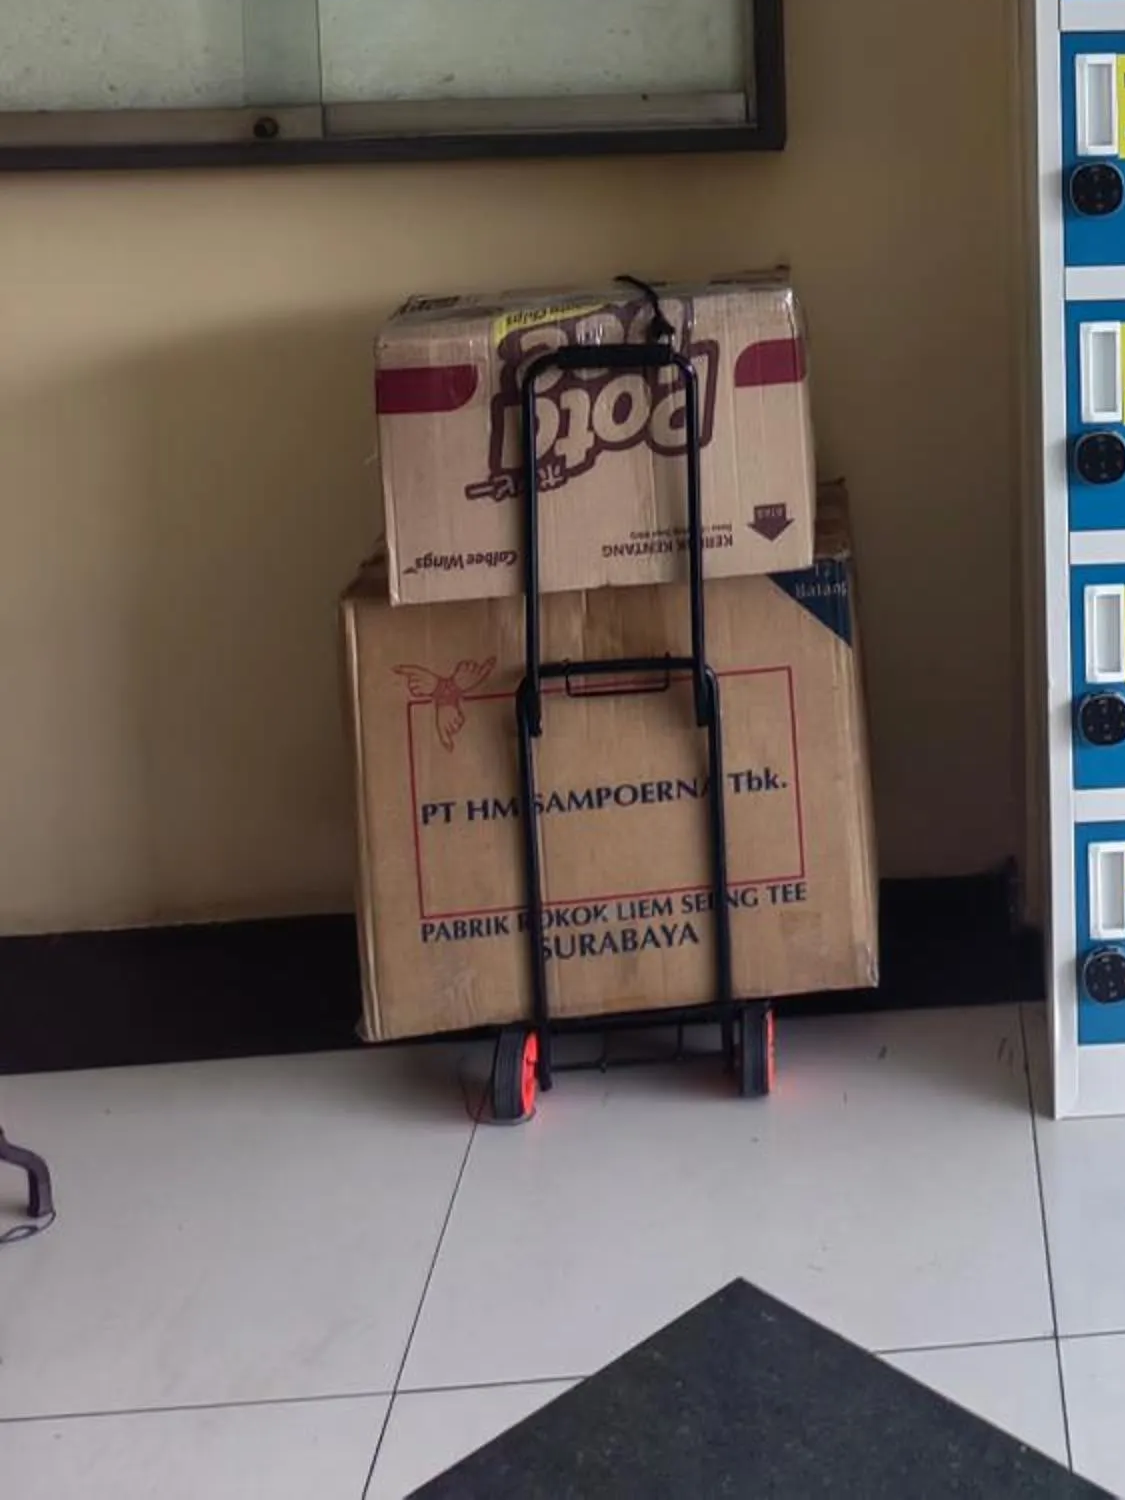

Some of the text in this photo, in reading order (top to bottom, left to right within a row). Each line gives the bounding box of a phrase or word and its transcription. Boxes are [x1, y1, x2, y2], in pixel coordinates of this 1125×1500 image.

[415, 550, 518, 571] Calbee Wings
[601, 540, 673, 558] KENTANG
[421, 802, 455, 825] PT
[466, 801, 519, 822] HM
[727, 769, 788, 795] Tbk.
[421, 915, 510, 943] PABRIK
[617, 896, 673, 922] LIEM
[766, 882, 808, 905] TEE
[541, 921, 699, 960] SURABAYA
